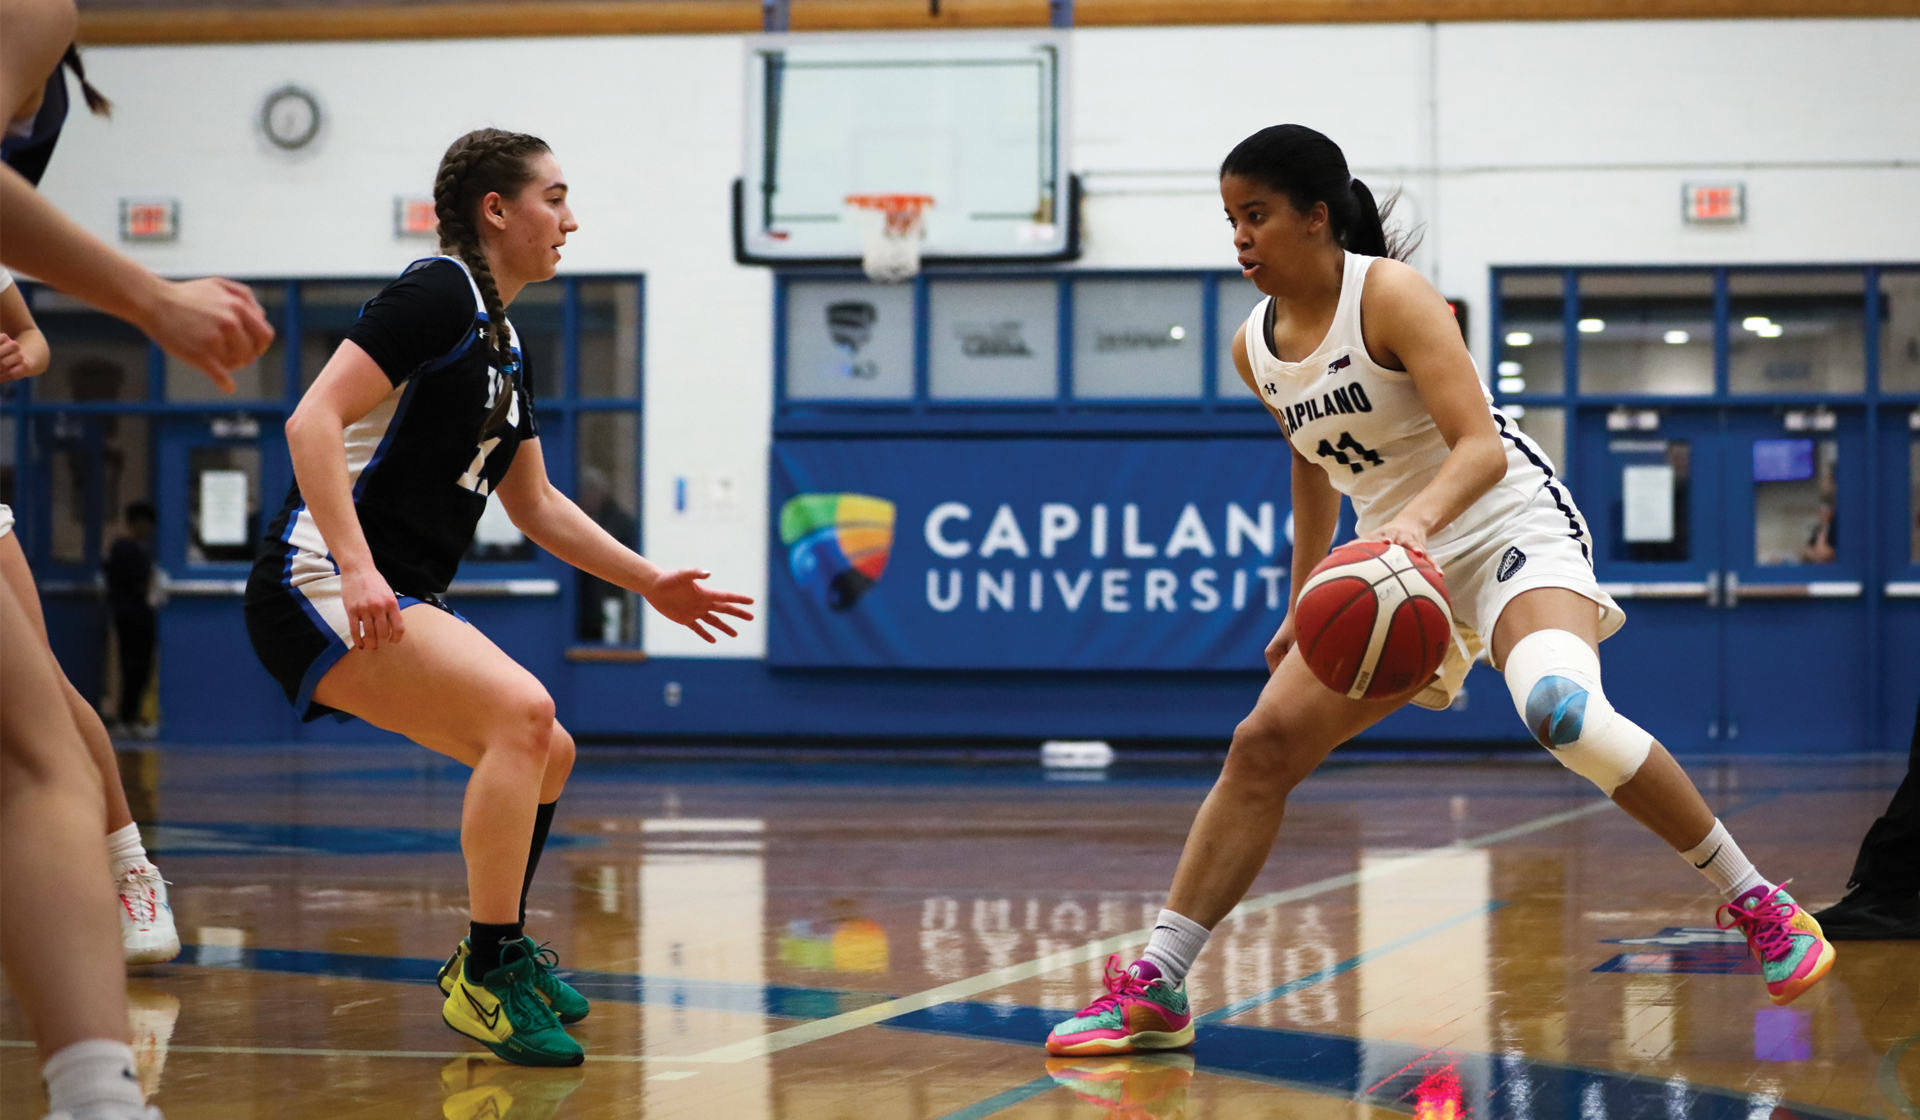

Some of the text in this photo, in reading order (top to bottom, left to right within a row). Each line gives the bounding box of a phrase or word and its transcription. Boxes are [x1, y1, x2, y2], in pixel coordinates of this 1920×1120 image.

[1316, 431, 1385, 475] 11
[924, 502, 1340, 558] CAPILAN
[926, 567, 1288, 612] UNIVERSIT
